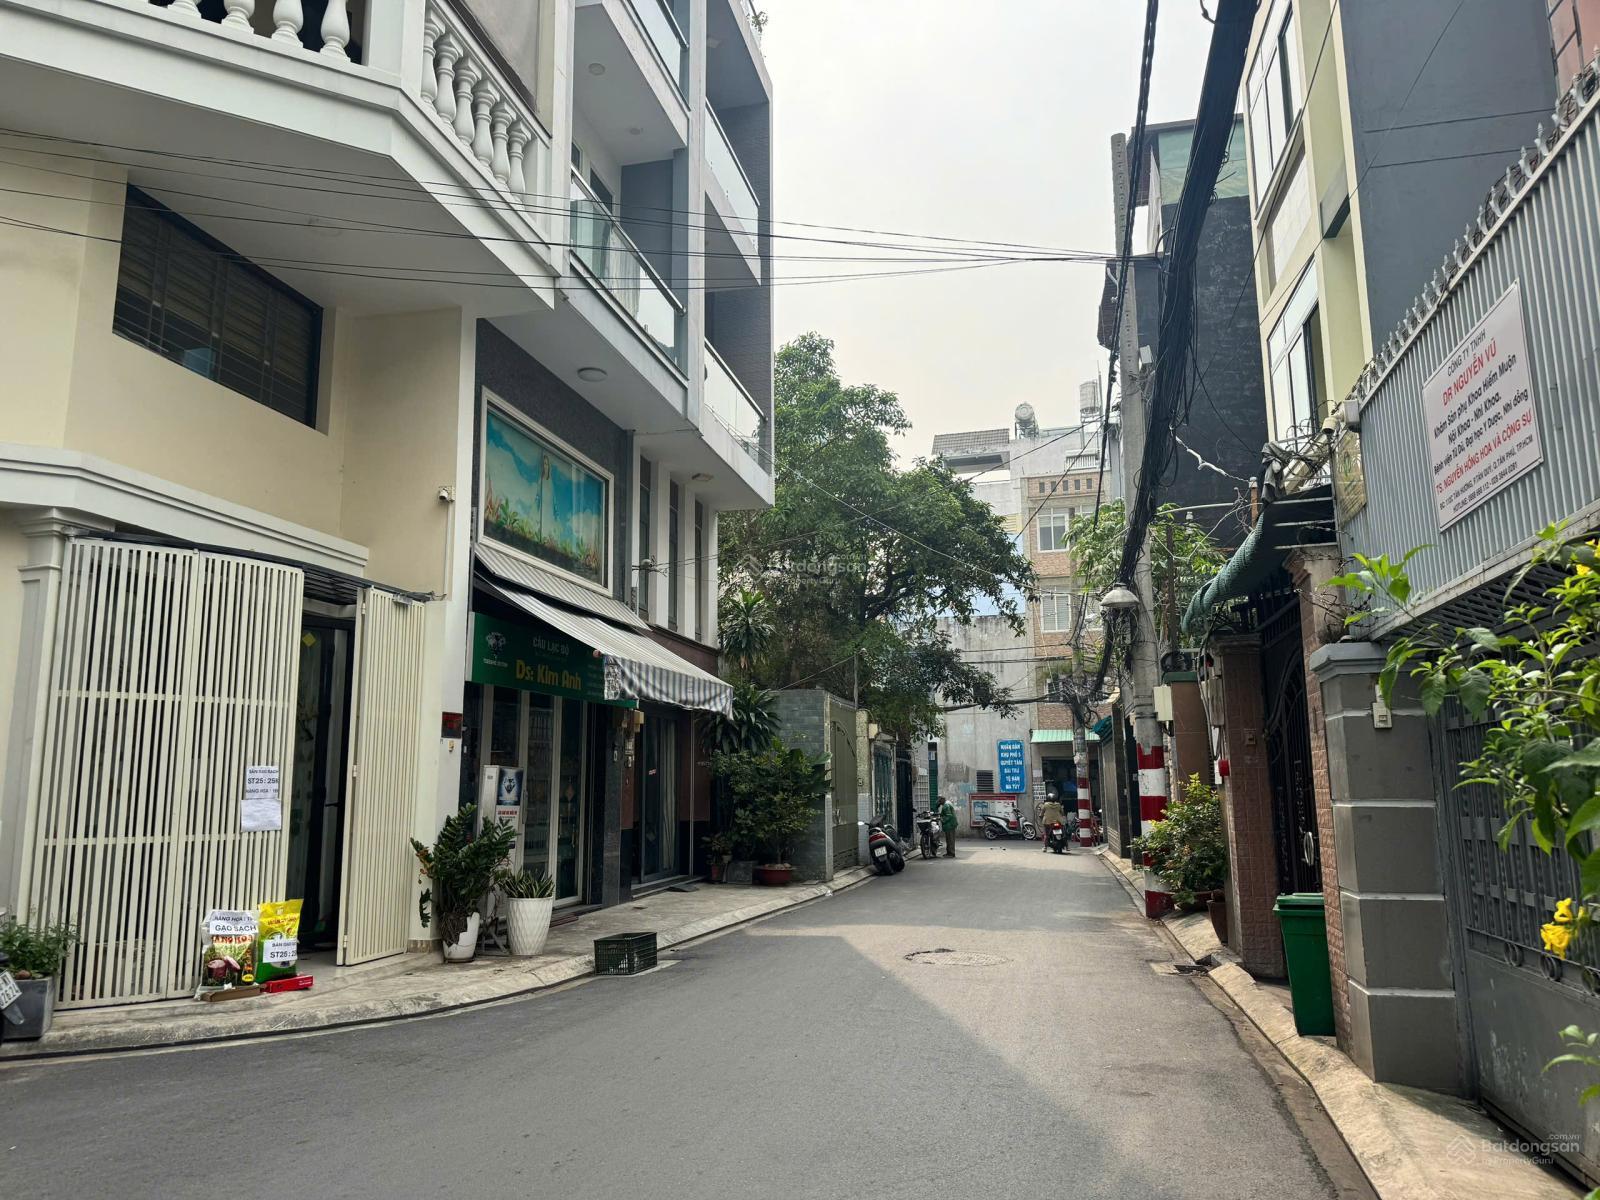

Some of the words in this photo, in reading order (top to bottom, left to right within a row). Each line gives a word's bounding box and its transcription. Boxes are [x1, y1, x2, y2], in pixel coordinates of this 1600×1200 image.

[1448, 355, 1462, 376] CÔNG
[1462, 346, 1469, 360] TY
[1470, 329, 1485, 351] TNHH
[1443, 386, 1452, 406] DR
[1468, 387, 1482, 406] Khoa
[1457, 418, 1470, 437] Khoa
[1480, 442, 1492, 459] HOA
[516, 659, 534, 680] Ds:
[537, 664, 559, 686] Kim
[562, 670, 582, 690] Anh
